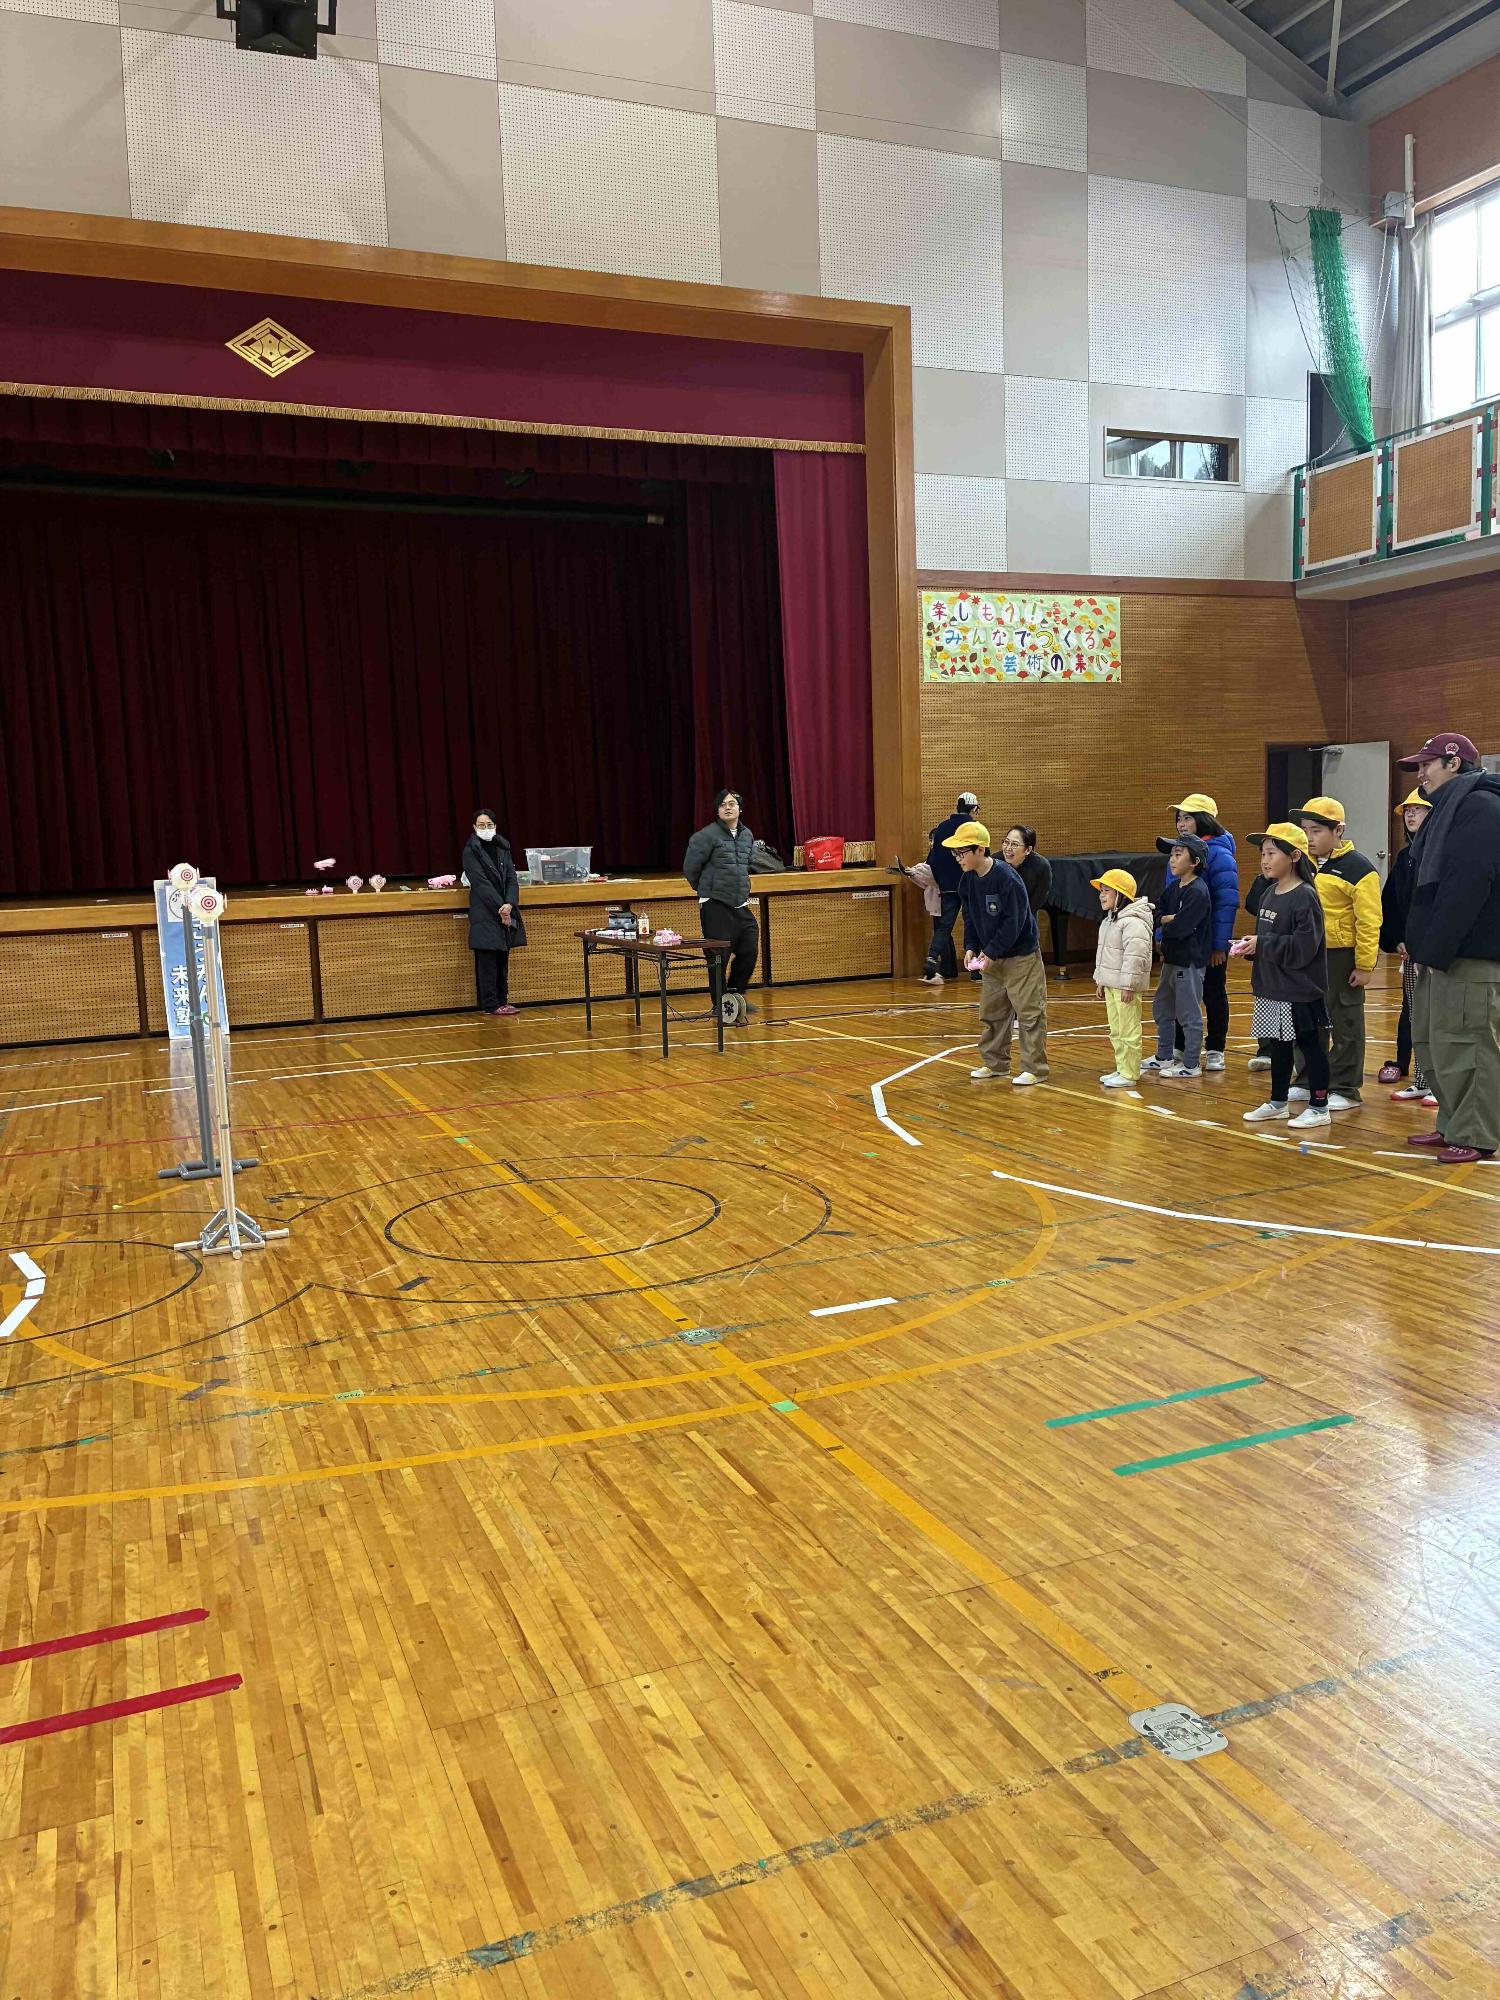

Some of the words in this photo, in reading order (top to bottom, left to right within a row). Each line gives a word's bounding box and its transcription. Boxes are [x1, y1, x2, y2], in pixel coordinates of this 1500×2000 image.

[944, 627, 1095, 650] みんなでつくる
[1003, 652, 1108, 674] 芸術の集い
